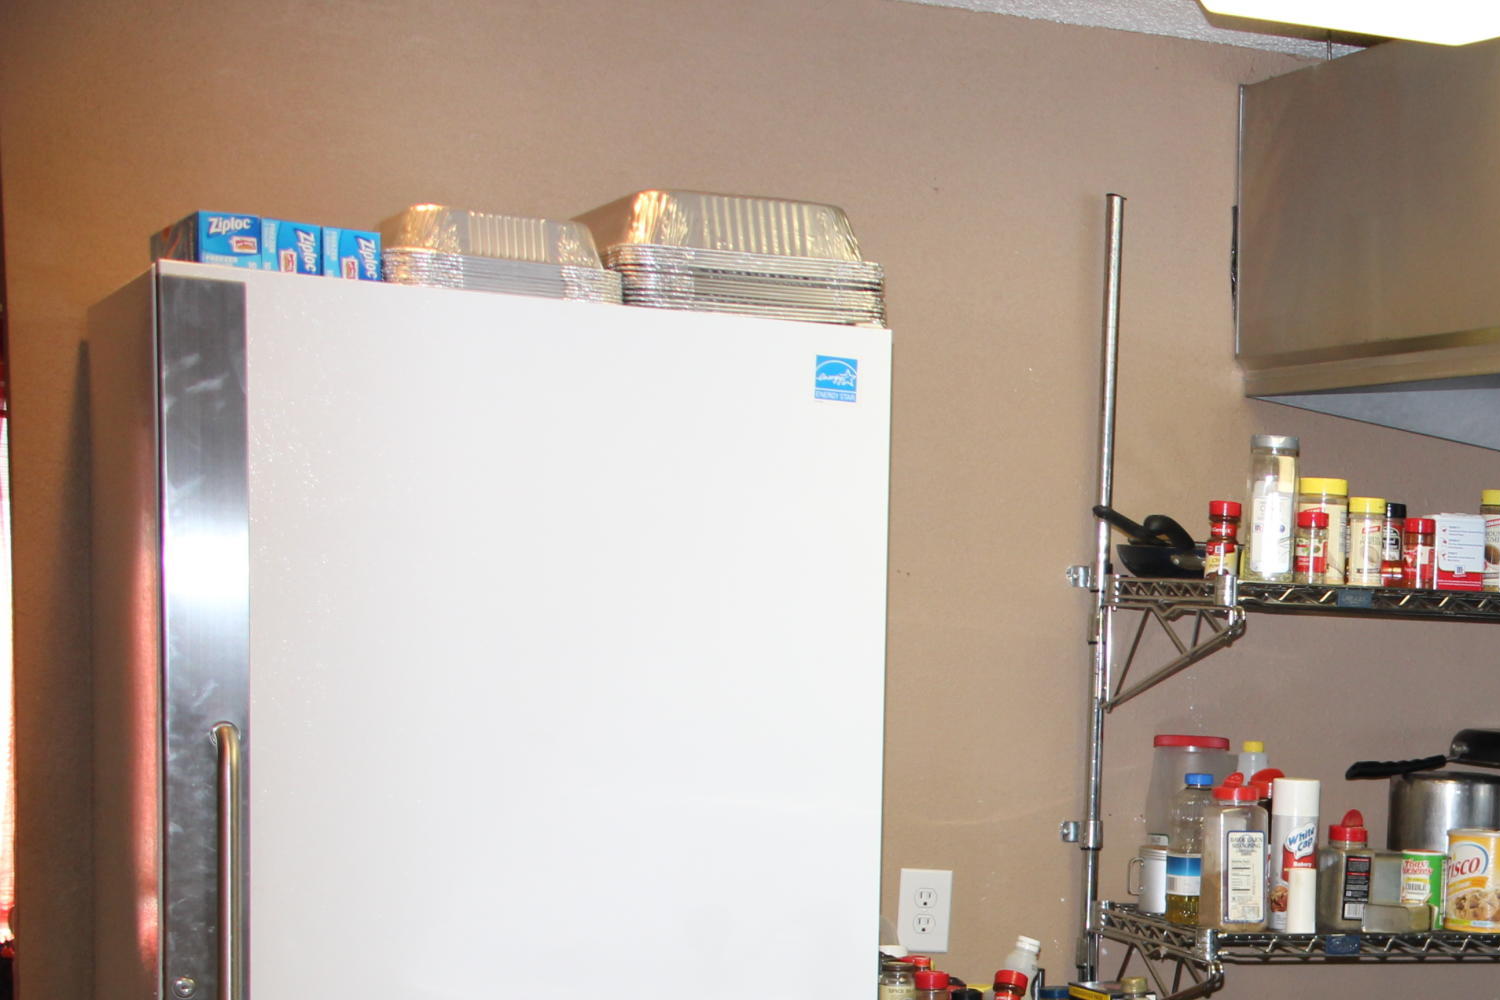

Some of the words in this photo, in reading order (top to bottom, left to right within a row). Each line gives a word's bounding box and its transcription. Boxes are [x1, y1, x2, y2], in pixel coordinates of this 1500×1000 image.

[208, 216, 252, 235] Ziploc
[297, 230, 317, 273] Ziploc
[358, 237, 378, 280] Ziploc
[1288, 827, 1315, 845] White
[1447, 857, 1480, 878] risco
